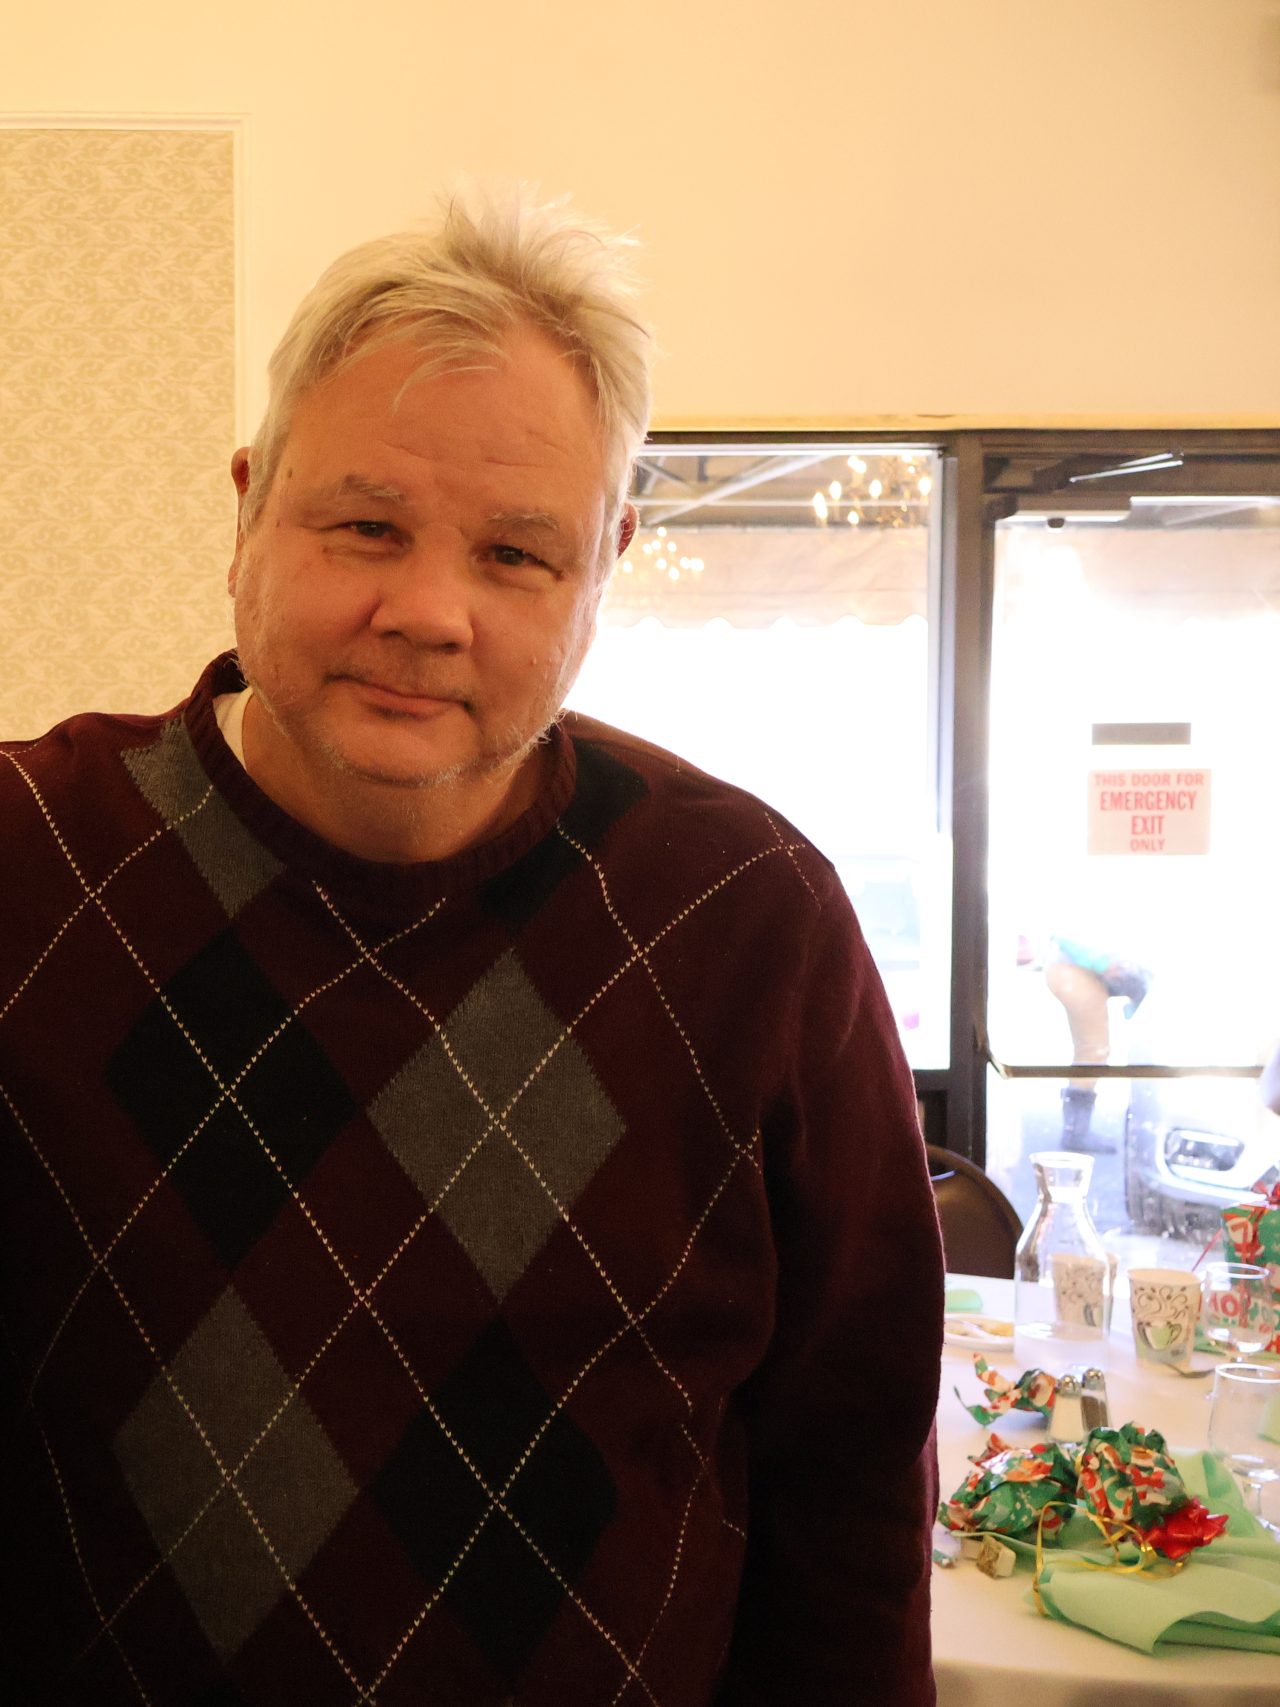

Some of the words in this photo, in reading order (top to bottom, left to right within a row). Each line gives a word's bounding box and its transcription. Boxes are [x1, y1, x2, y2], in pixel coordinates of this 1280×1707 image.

[1095, 774, 1126, 787] THIS
[1131, 773, 1170, 787] DOOR
[1176, 773, 1204, 786] FOR
[1100, 791, 1197, 811] EMERGENCY
[1131, 815, 1165, 835] EXIT
[1130, 838, 1166, 852] ONLY
